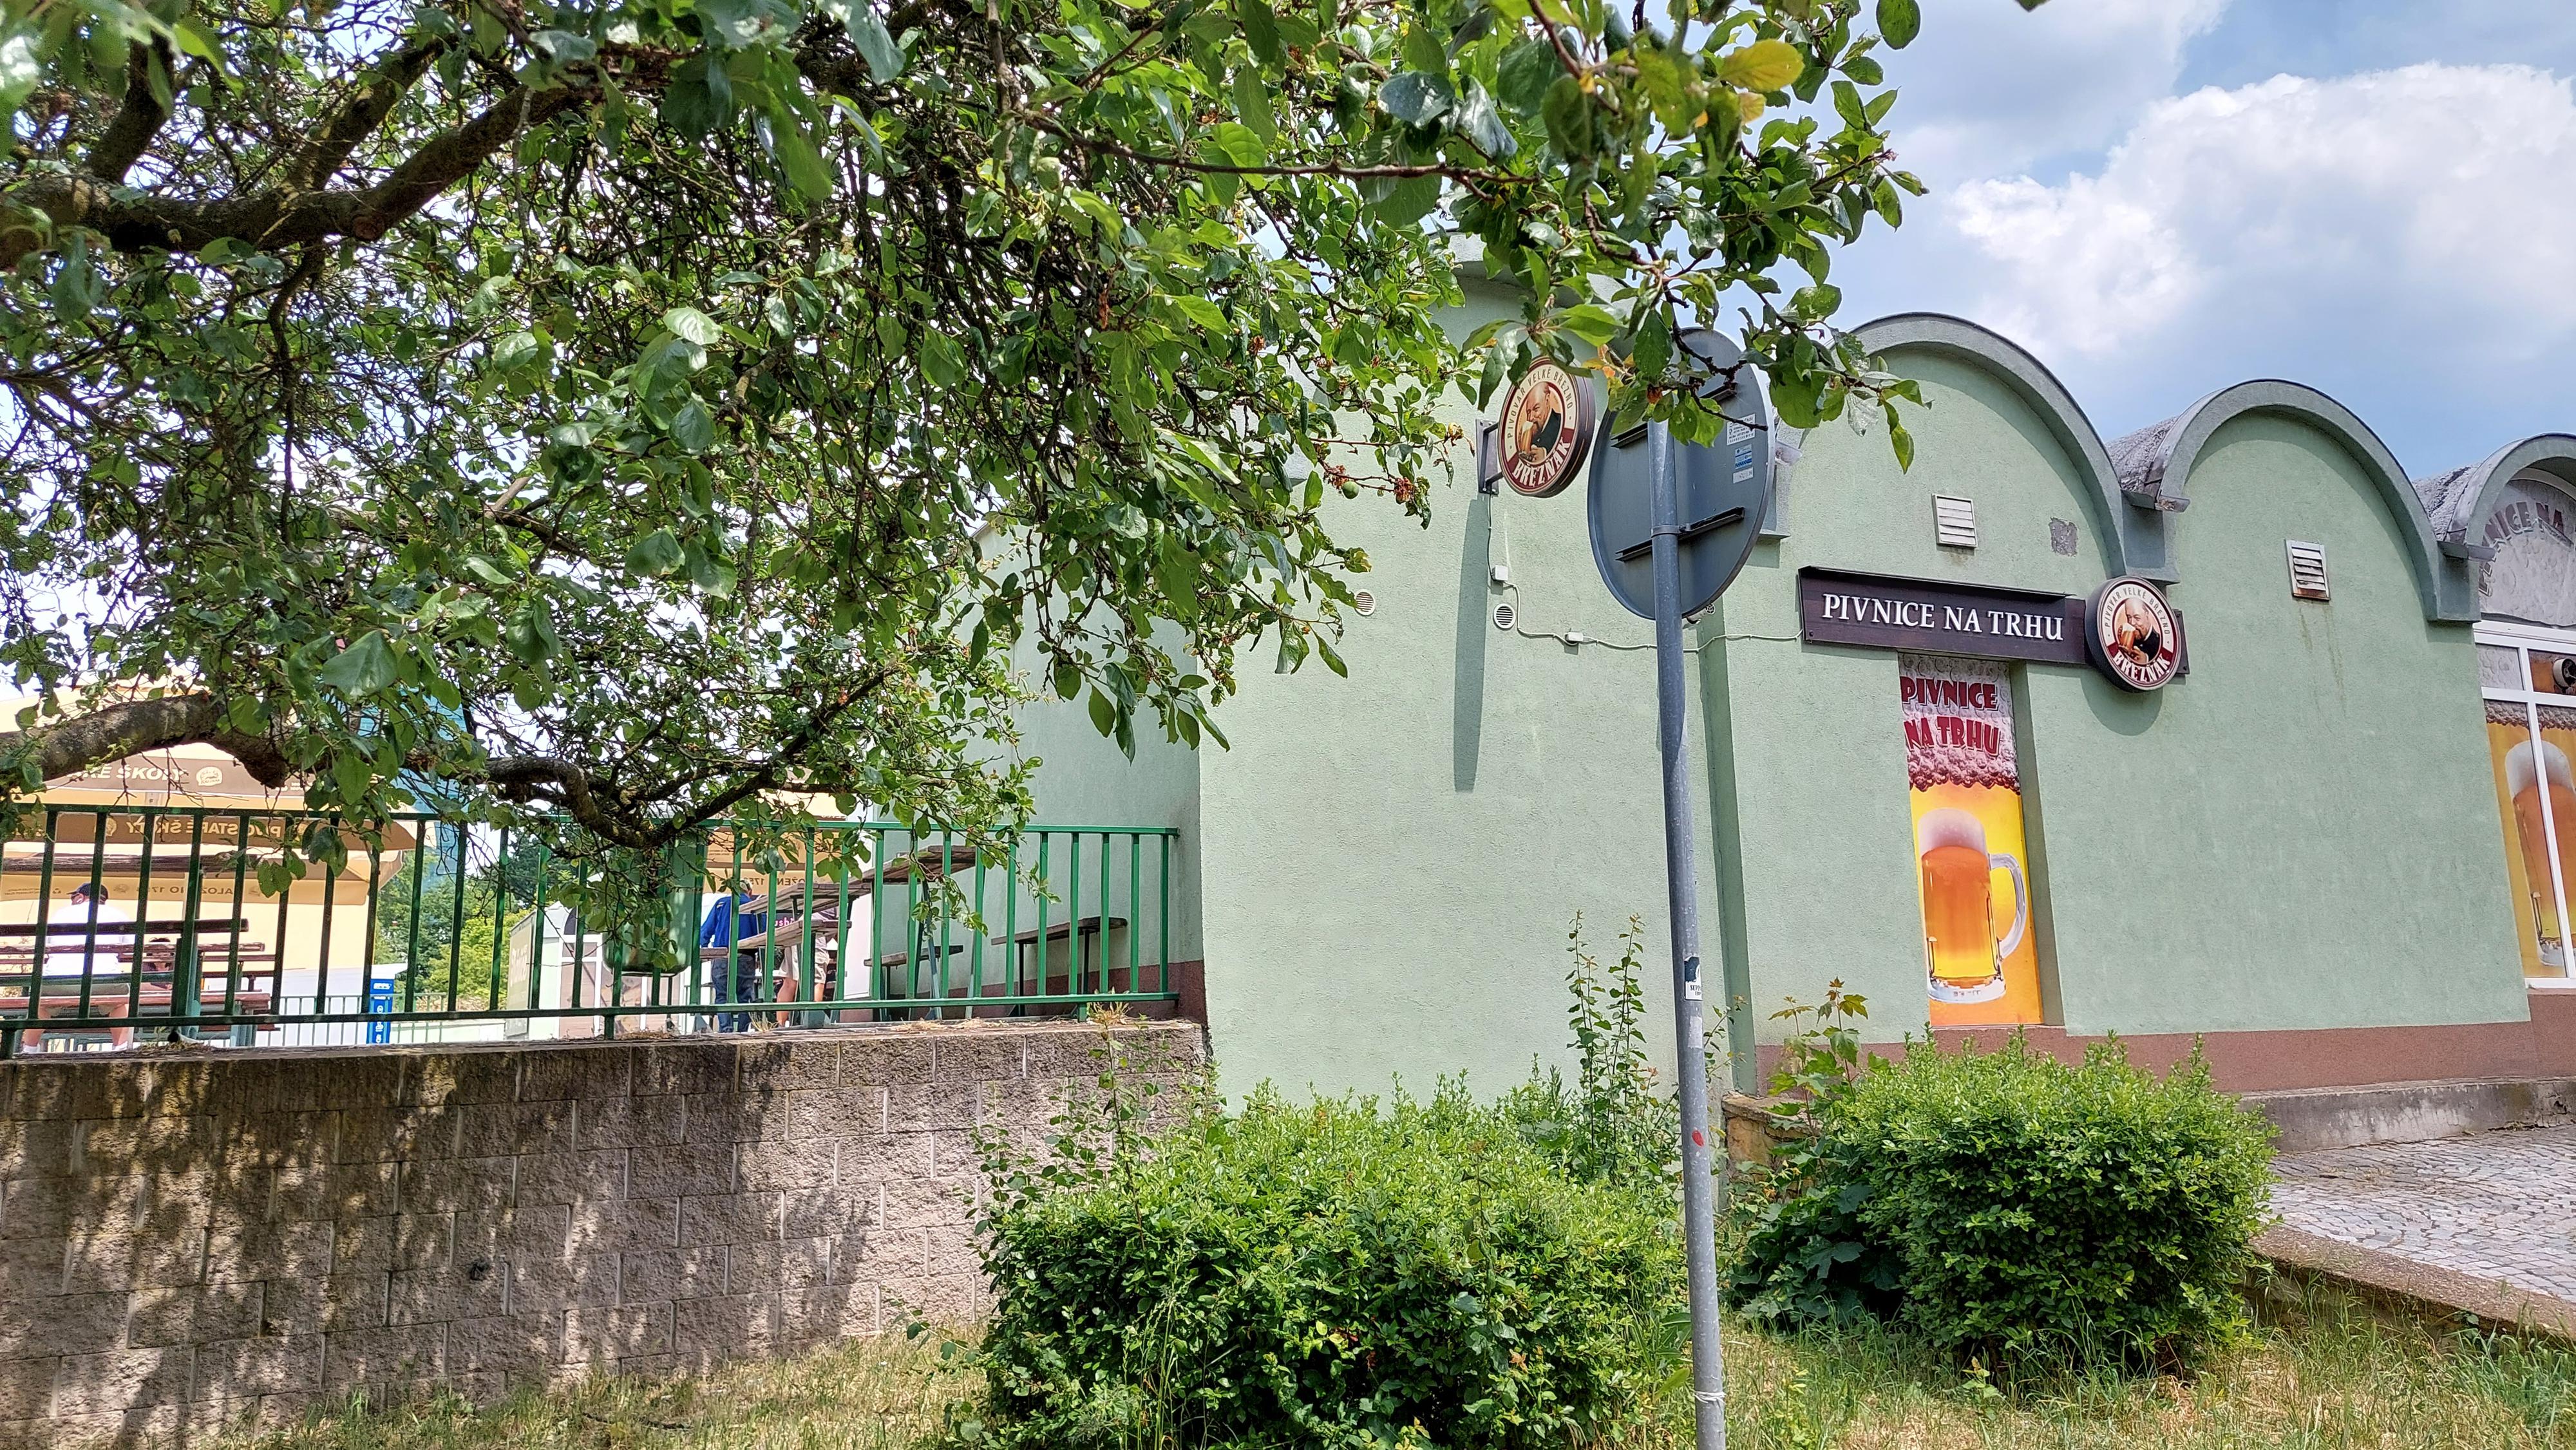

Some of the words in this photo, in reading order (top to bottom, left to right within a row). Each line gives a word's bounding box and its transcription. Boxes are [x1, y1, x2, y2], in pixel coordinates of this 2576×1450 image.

[1507, 388, 1526, 438] PIVOVAR
[1527, 367, 1551, 385] VELKÉ
[1553, 371, 1573, 410] BŘEZNO
[1822, 593, 1935, 628] PIVNICE
[1942, 606, 1982, 633] NA
[1987, 610, 2063, 641] TRHU
[2105, 592, 2121, 628] PIVOVAR
[2123, 587, 2146, 599] VELKÉ
[1900, 676, 1999, 711] PIVNICE
[1904, 717, 1935, 752] NA
[1937, 716, 2001, 757] TRHU
